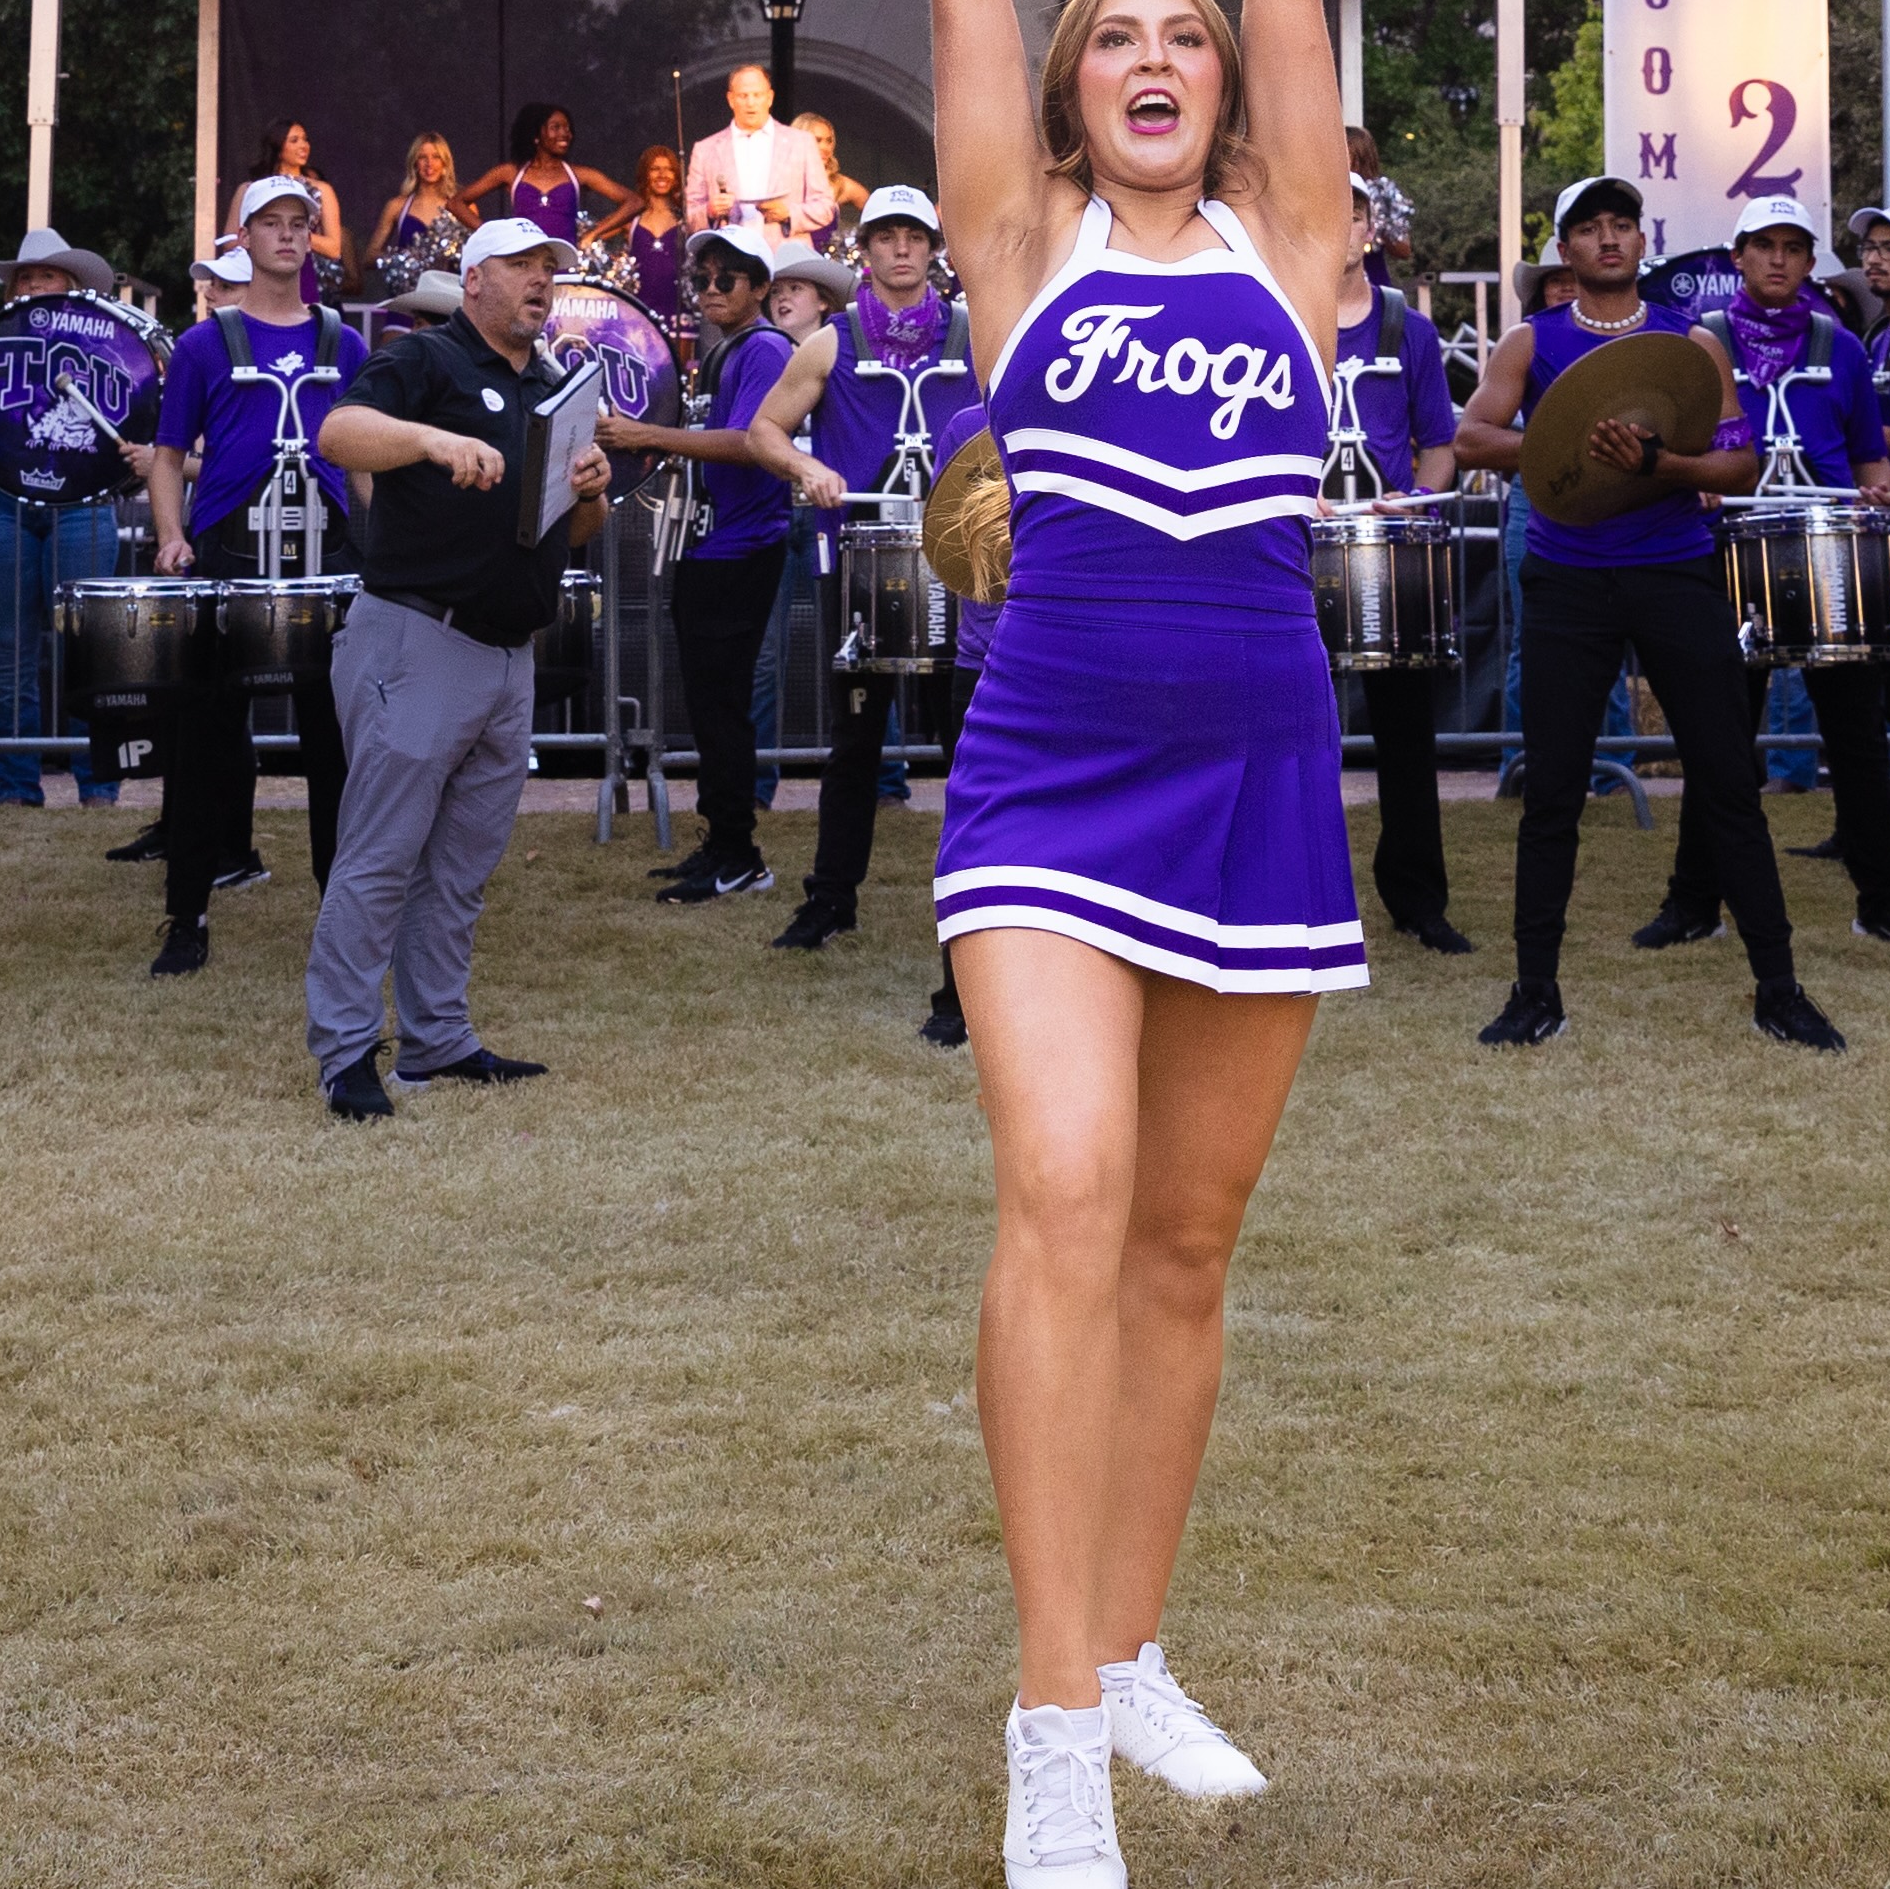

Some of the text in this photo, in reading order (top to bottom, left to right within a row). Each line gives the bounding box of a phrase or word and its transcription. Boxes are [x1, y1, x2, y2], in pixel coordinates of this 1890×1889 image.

[51, 311, 115, 340] YAMAHA
[552, 297, 618, 320] YAMAHA
[1045, 305, 1295, 440] Frogs
[928, 581, 946, 647] YAMAHA
[1362, 576, 1381, 644] YAMAHA
[1827, 566, 1848, 634] YAMAHA
[104, 694, 148, 708] YAMAHA
